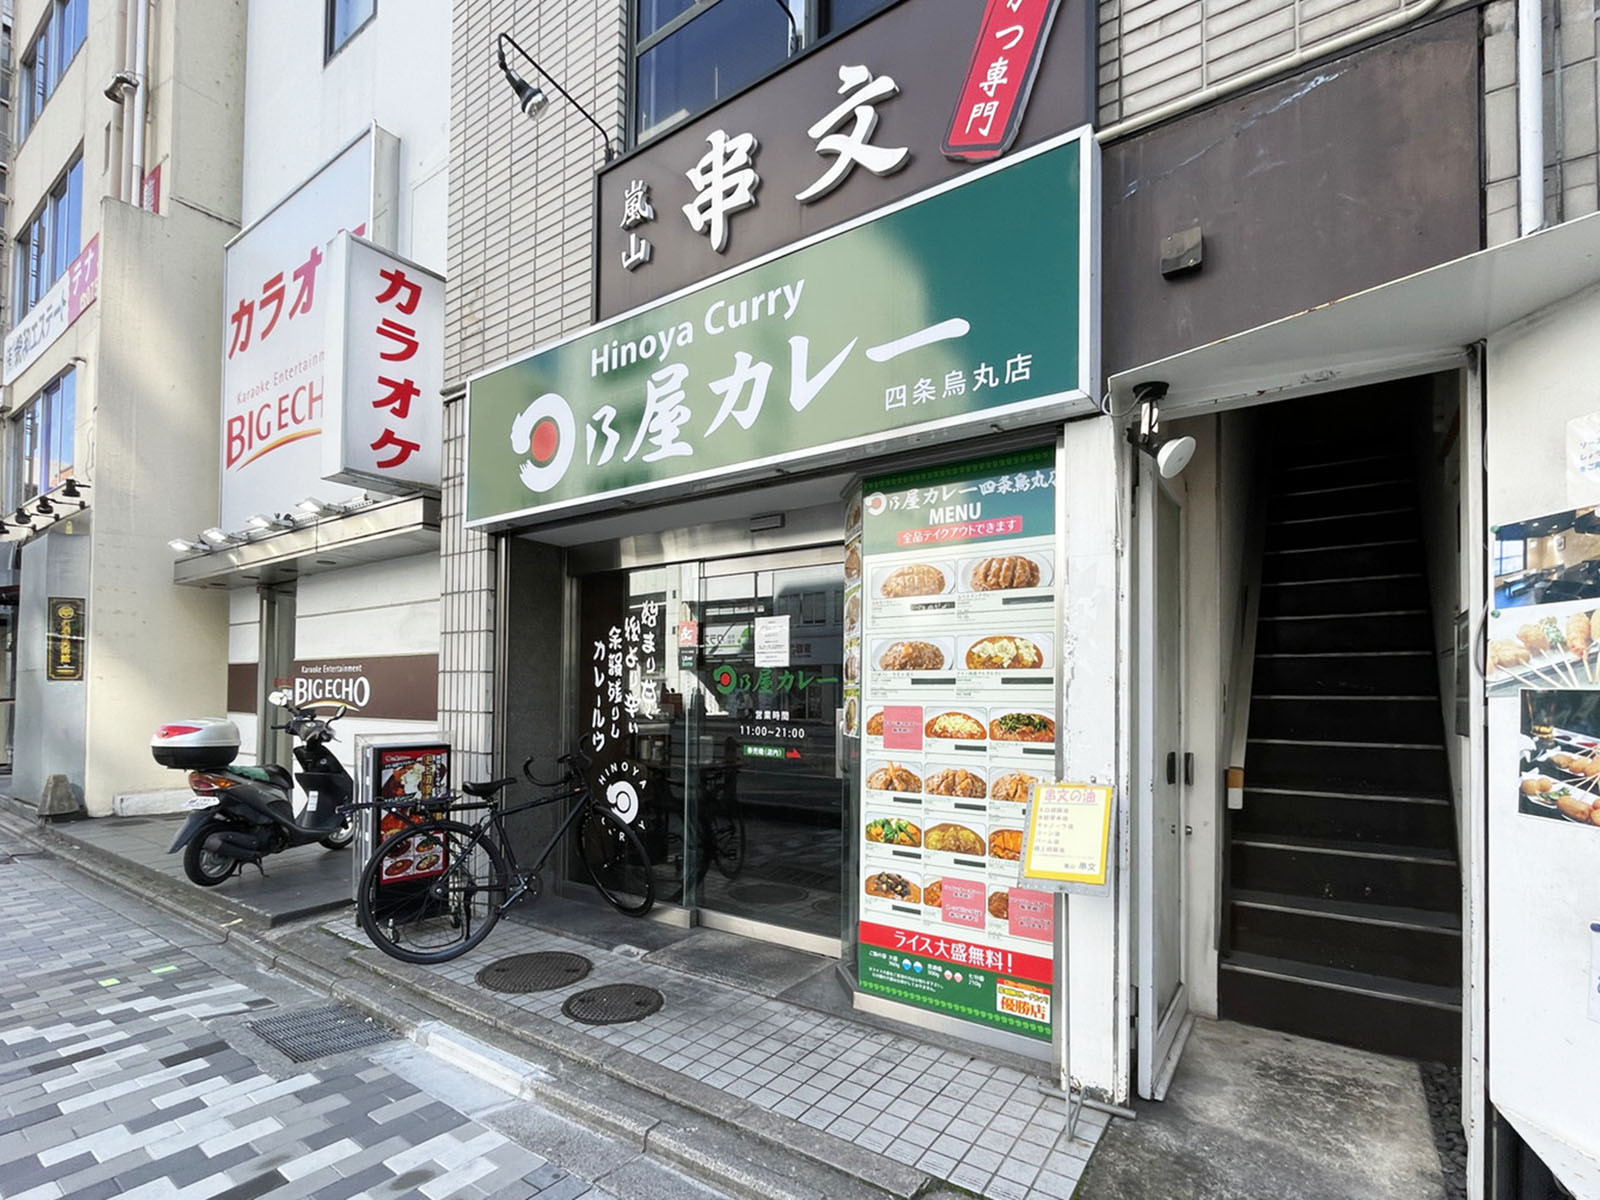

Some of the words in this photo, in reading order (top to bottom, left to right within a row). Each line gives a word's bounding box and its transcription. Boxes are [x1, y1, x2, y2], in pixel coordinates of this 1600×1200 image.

[682, 63, 911, 254] 串文
[619, 177, 655, 272] 嵐山
[589, 320, 694, 379] Hinoya
[703, 278, 806, 339] Curry
[370, 268, 422, 469] カラオケ
[884, 352, 1034, 412] 四条烏丸店
[236, 378, 271, 405] Karaoke
[902, 519, 1018, 545] 全品テイクアウトできます
[929, 501, 982, 526] MENU
[301, 665, 322, 674] Karaoke
[322, 664, 363, 673] Entertainment
[591, 640, 606, 753] カレールウ
[755, 710, 790, 721] 営業時間
[597, 761, 647, 790] HINOYA
